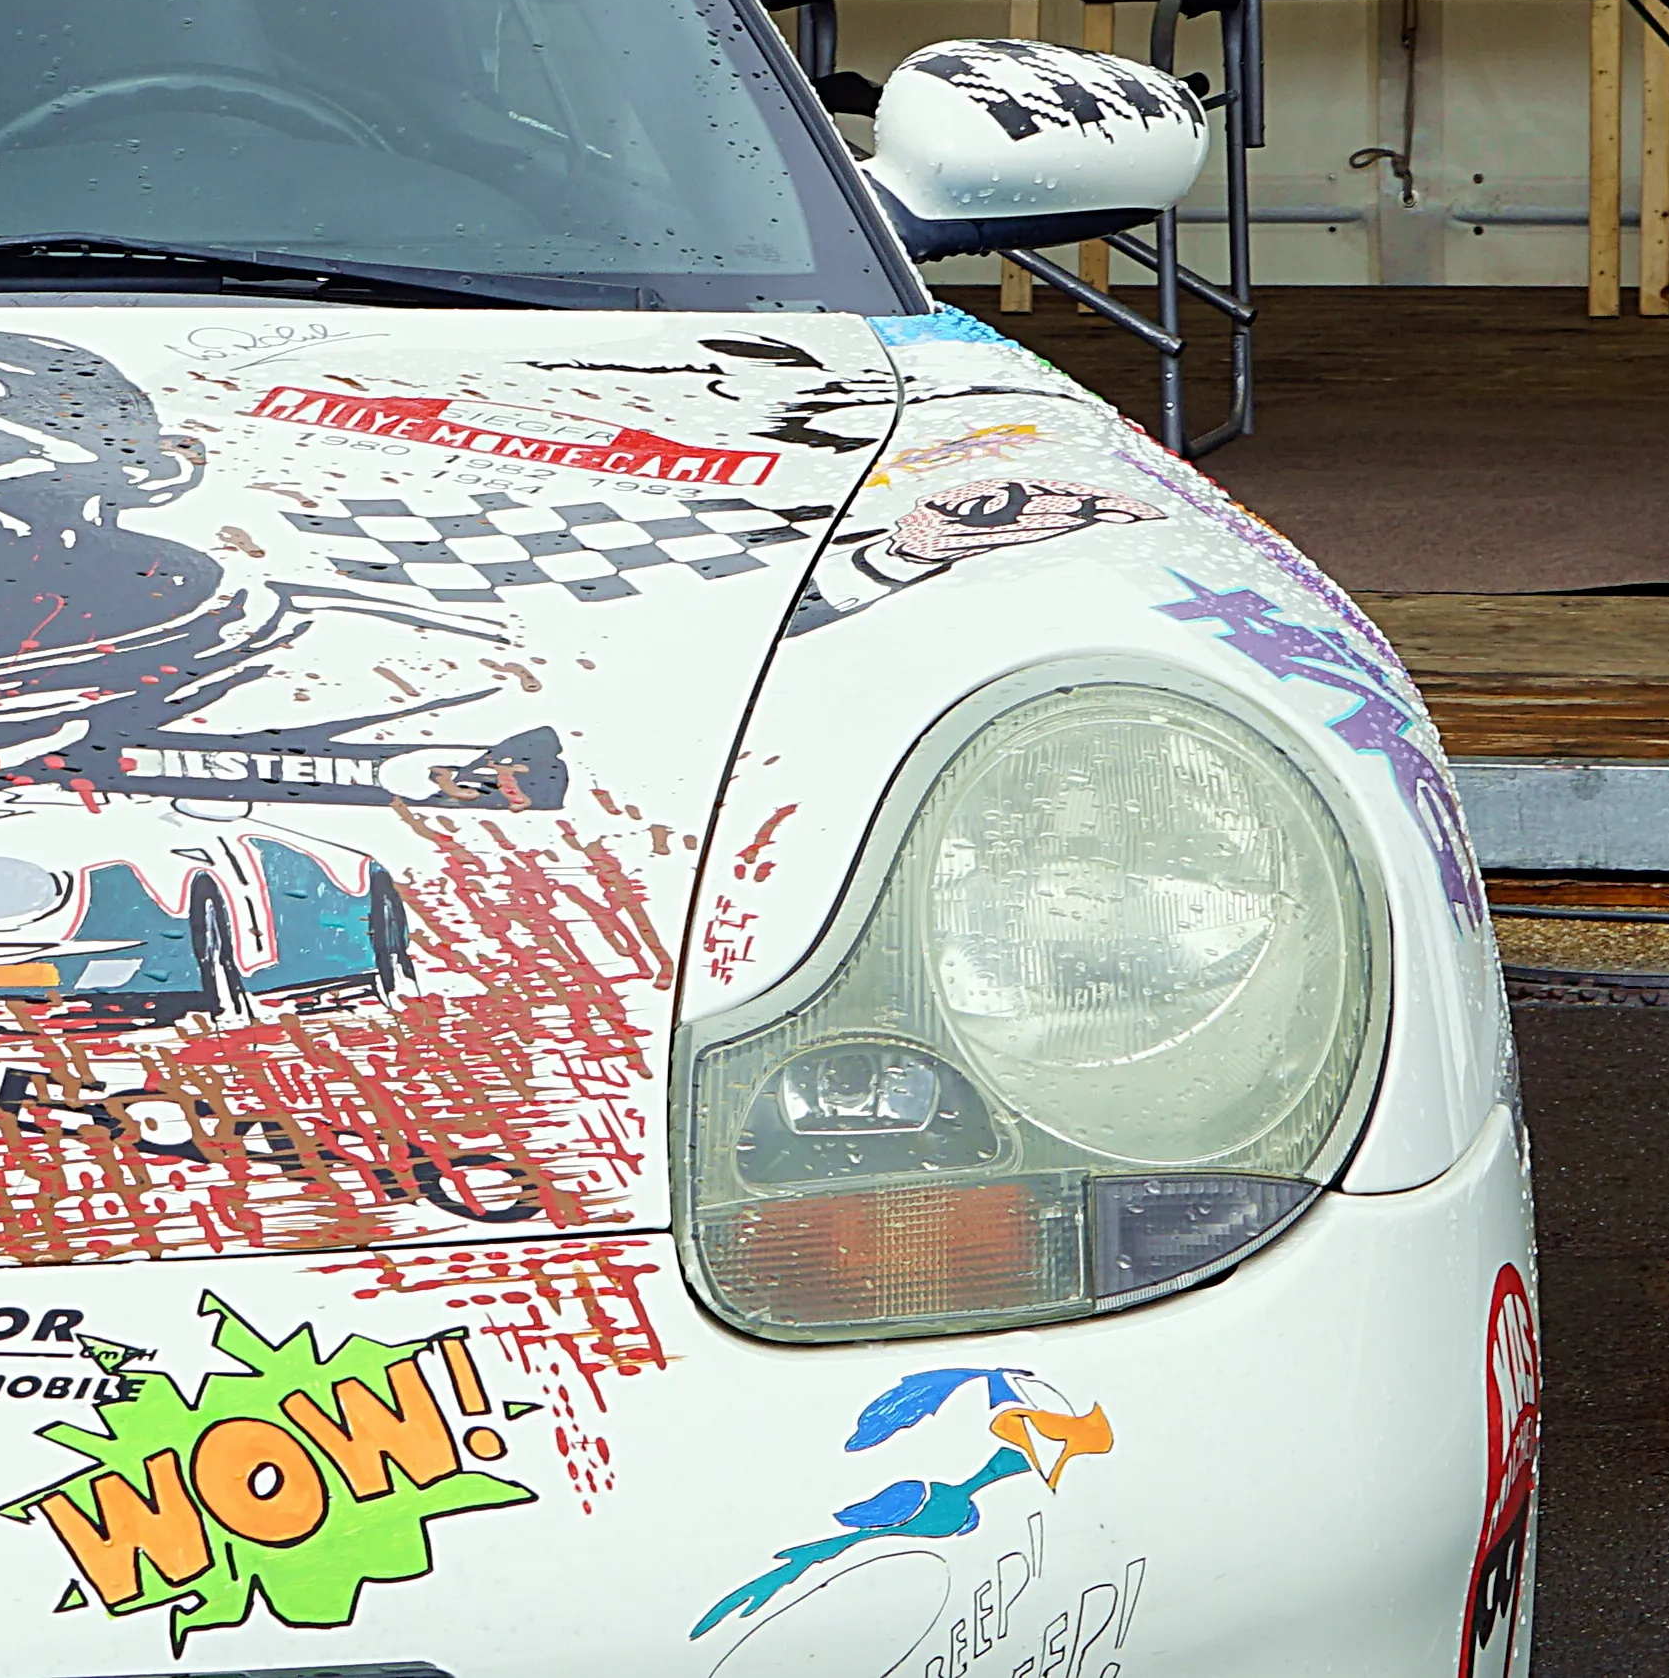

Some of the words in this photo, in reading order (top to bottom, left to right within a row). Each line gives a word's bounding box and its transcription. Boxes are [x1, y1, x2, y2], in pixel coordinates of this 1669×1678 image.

[262, 388, 428, 440] RALLYE
[430, 424, 774, 486] MONTE-CARLO
[298, 433, 412, 456] 1980
[443, 453, 558, 480] 1982
[586, 478, 702, 500] 1983
[430, 468, 544, 495] 1984
[122, 746, 378, 788] BILSTEIN
[39, 1334, 508, 1610] WOW!
[925, 1511, 1044, 1678] EEP!
